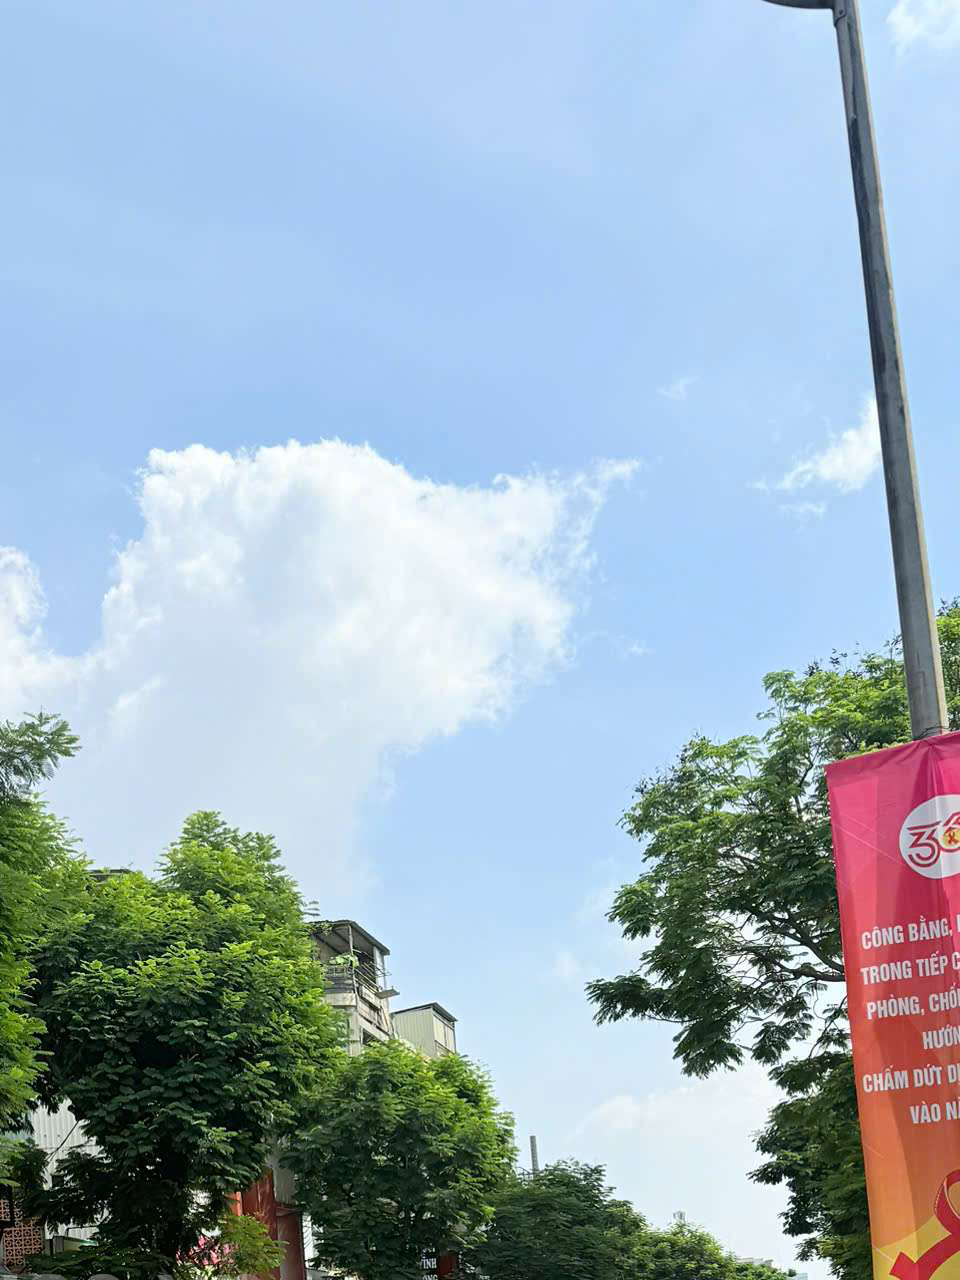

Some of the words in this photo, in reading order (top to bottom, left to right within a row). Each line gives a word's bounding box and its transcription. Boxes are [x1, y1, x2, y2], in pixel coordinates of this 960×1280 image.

[861, 926, 905, 950] CÔNG
[908, 915, 953, 942] BẰNG,
[860, 960, 913, 985] TRONG
[916, 950, 949, 977] TIẾP
[866, 993, 925, 1020] PHÒNG,
[862, 1064, 909, 1092] CHẤM
[913, 1063, 943, 1088] DỨT
[909, 1100, 942, 1124] VÀO
